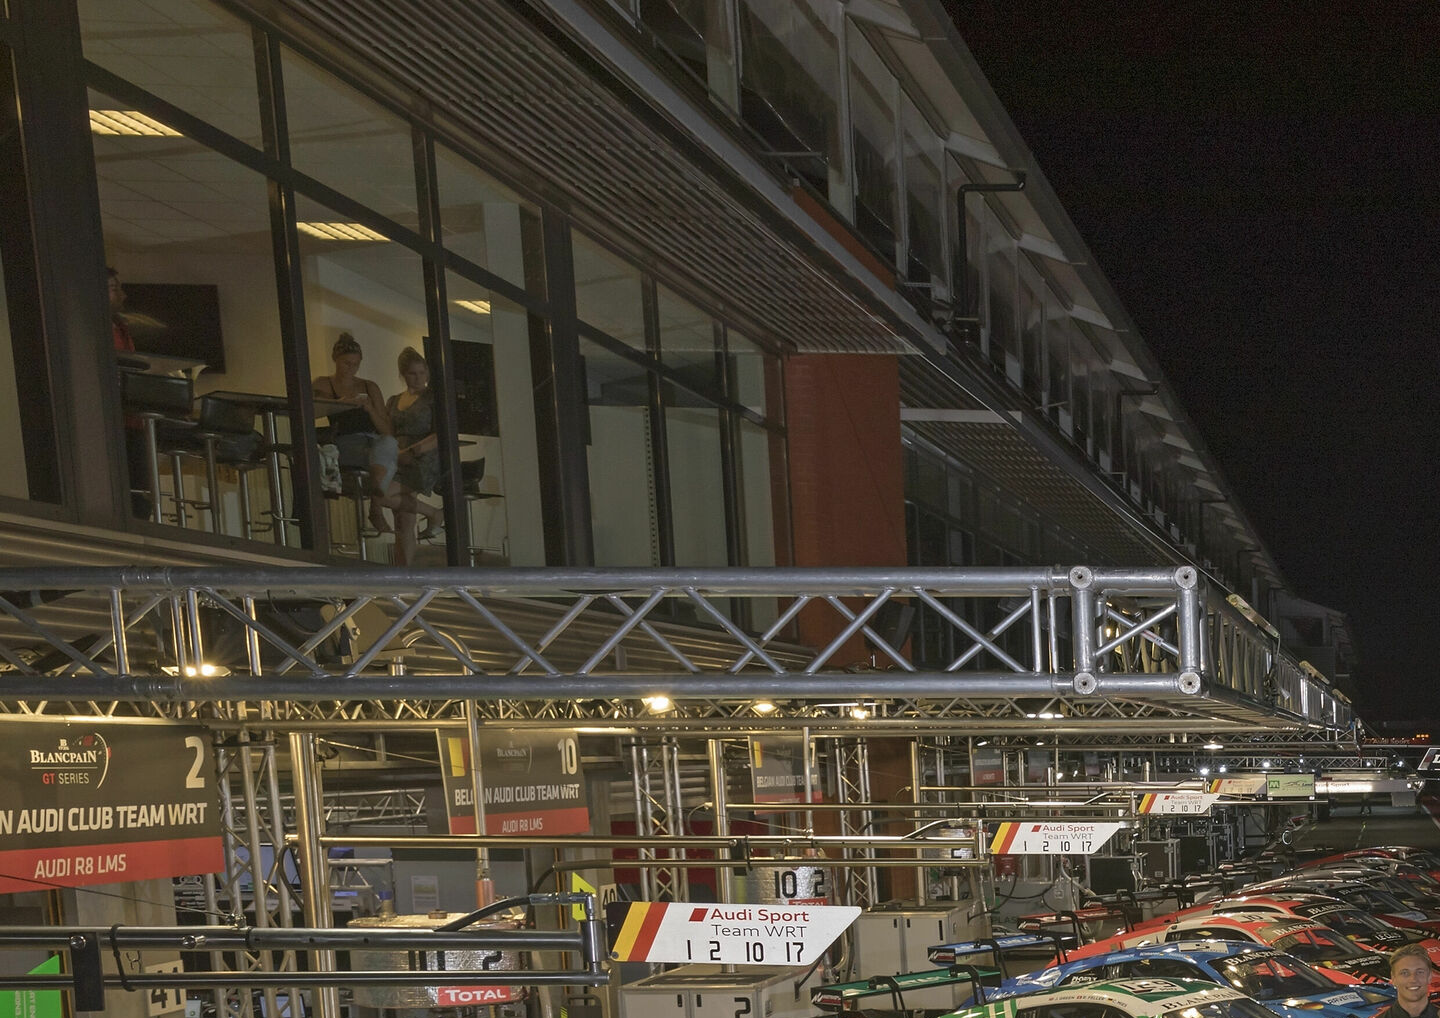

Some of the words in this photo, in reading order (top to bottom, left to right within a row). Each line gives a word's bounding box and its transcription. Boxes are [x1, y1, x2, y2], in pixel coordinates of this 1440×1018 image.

[30, 749, 97, 764] BLANCPAIN
[185, 735, 205, 789] 2
[557, 738, 578, 775] 10
[42, 773, 55, 784] GT
[58, 772, 90, 785] SERIES
[494, 786, 514, 803] AUDI
[515, 786, 536, 801] CLUB
[537, 785, 560, 800] TEAM
[560, 783, 580, 799] WRT
[17, 807, 63, 834] AUDI
[67, 806, 113, 831] CLUB
[117, 804, 165, 828] TEAM
[168, 802, 207, 826] WRT
[502, 820, 518, 833] AUDI
[530, 818, 543, 831] LMS
[1068, 825, 1094, 835] Sport
[1043, 841, 1049, 852] 2
[1060, 841, 1071, 852] 10
[1082, 841, 1092, 852] 17
[34, 857, 71, 879] AUDI
[75, 857, 94, 876] R8
[98, 853, 127, 874] LMS
[775, 870, 798, 898] 10
[813, 870, 826, 897] 2
[711, 908, 752, 921] Audi
[758, 908, 810, 924] Sport
[711, 924, 760, 937] Team
[767, 925, 807, 938] WRT
[687, 940, 692, 960] 1
[709, 941, 722, 961] 2
[746, 942, 764, 962] 10
[786, 942, 804, 962] 17
[445, 989, 507, 1002] TOTAL
